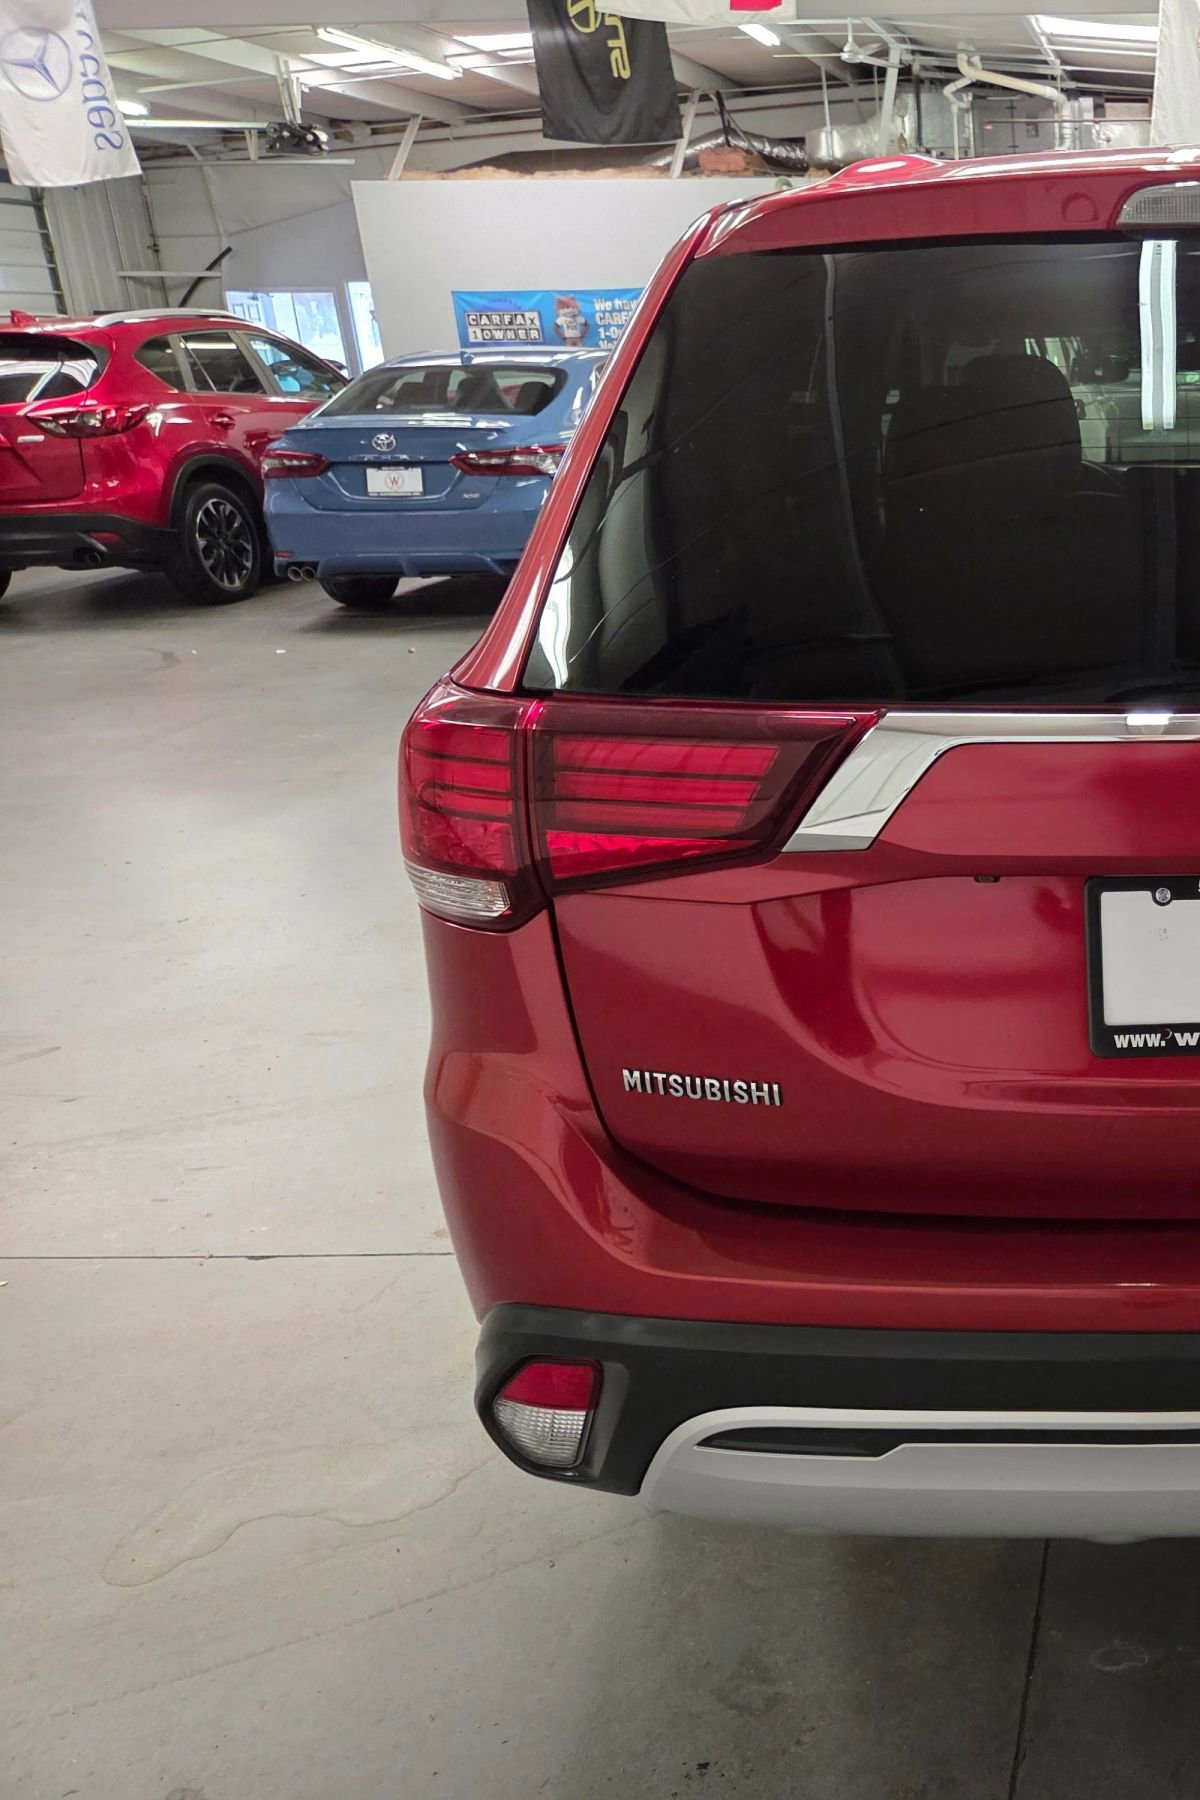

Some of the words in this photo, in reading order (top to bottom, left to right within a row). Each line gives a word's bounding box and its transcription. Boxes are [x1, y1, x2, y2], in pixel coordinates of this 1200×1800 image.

[593, 298, 612, 310] We
[614, 298, 641, 311] hav
[467, 313, 538, 327] CARFAX
[595, 311, 634, 325] CARF
[622, 1067, 783, 1107] MITSUBISHI
